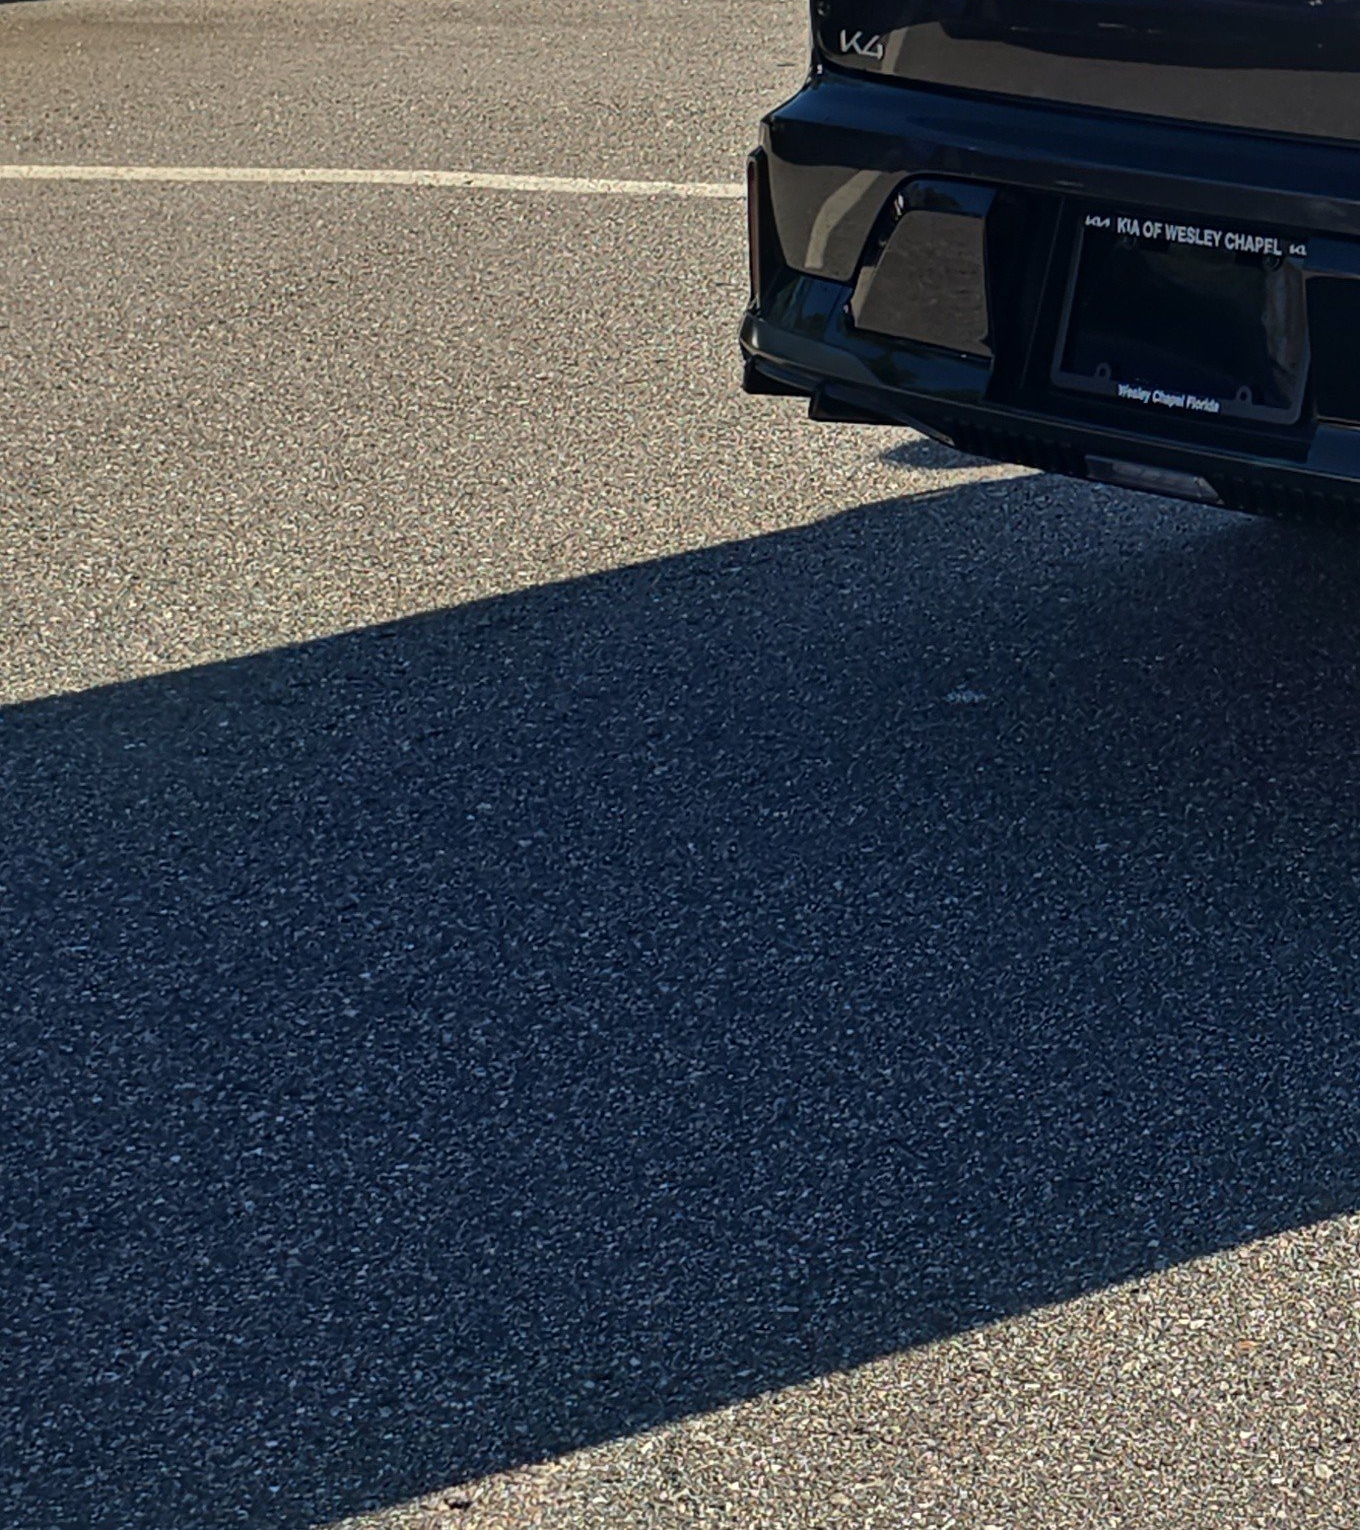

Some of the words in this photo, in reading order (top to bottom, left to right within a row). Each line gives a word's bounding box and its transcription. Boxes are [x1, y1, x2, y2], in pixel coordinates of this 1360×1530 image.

[840, 29, 883, 60] K4
[1117, 217, 1140, 237] KIA
[1142, 221, 1162, 239] OF
[1164, 223, 1222, 247] WESLEY
[1224, 232, 1282, 255] CHAPEL
